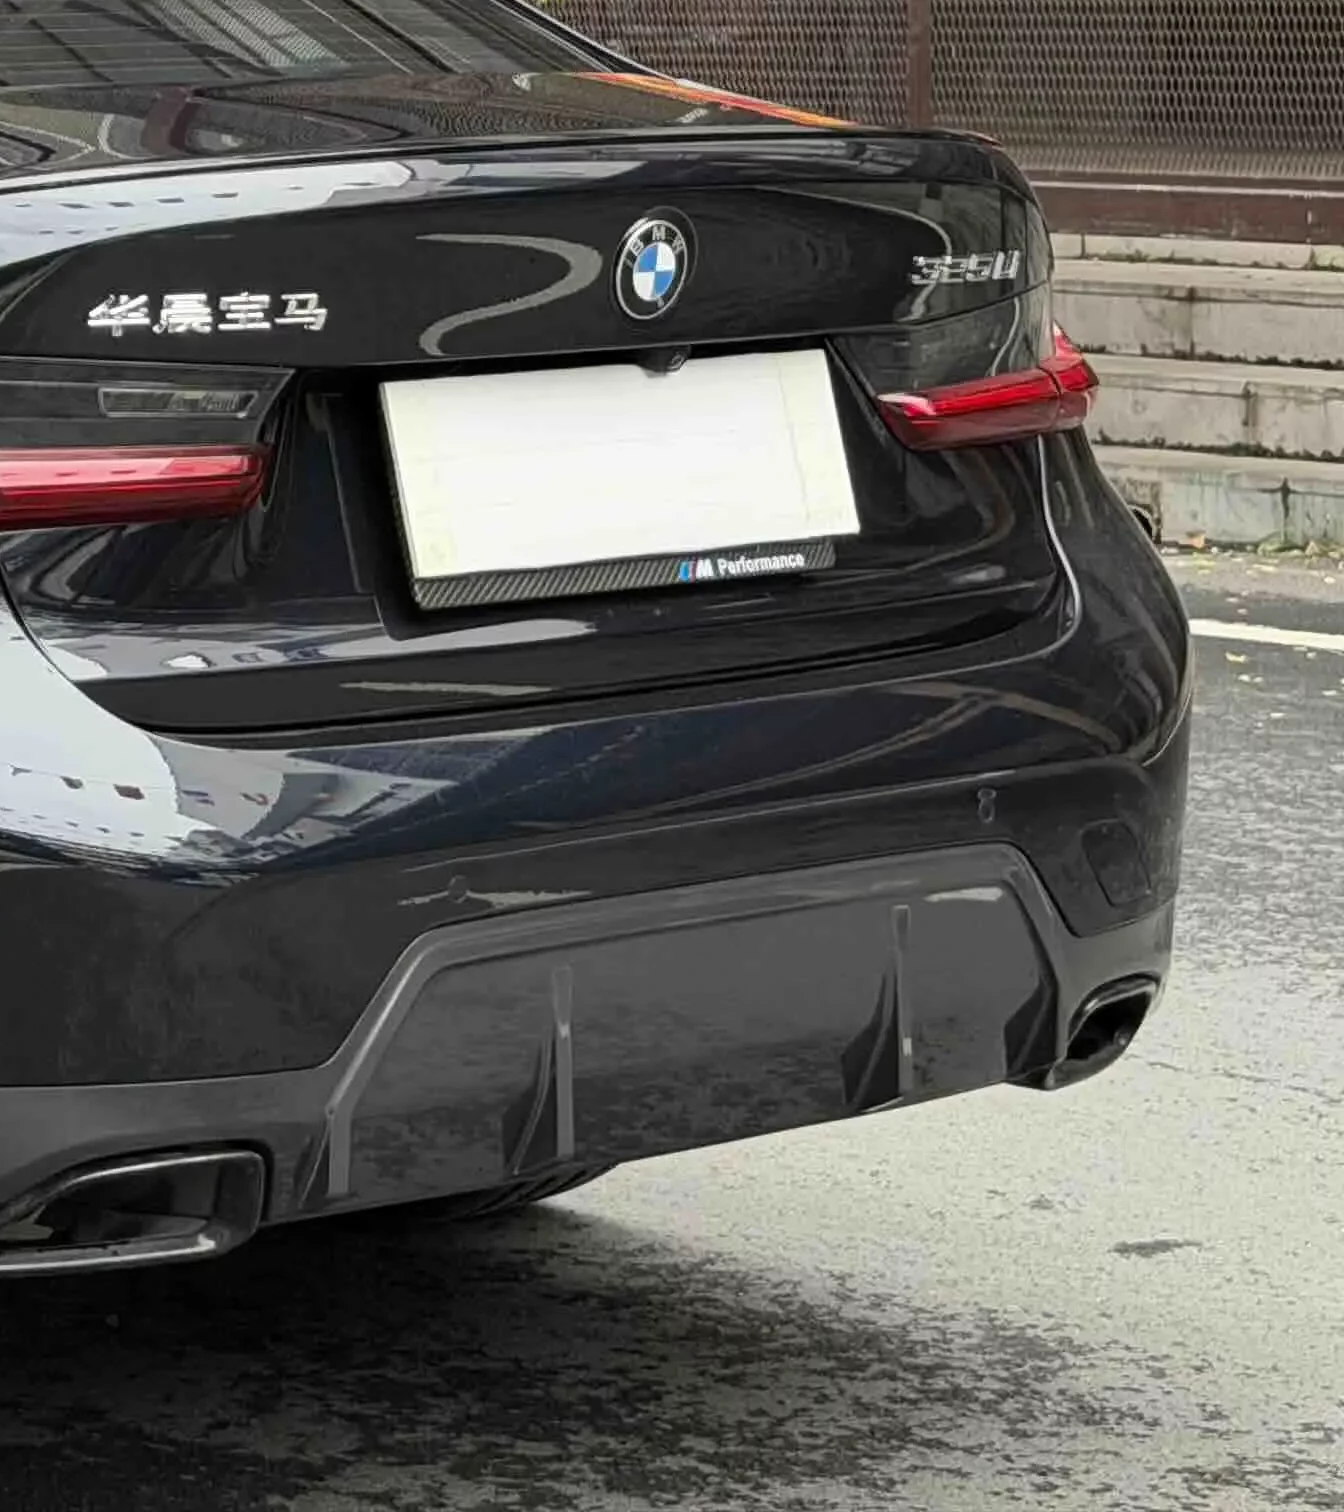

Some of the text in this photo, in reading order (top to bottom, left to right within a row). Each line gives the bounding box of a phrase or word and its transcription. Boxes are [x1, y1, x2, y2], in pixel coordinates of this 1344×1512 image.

[87, 291, 328, 337] 华晨宝马
[716, 552, 805, 577] Performance
